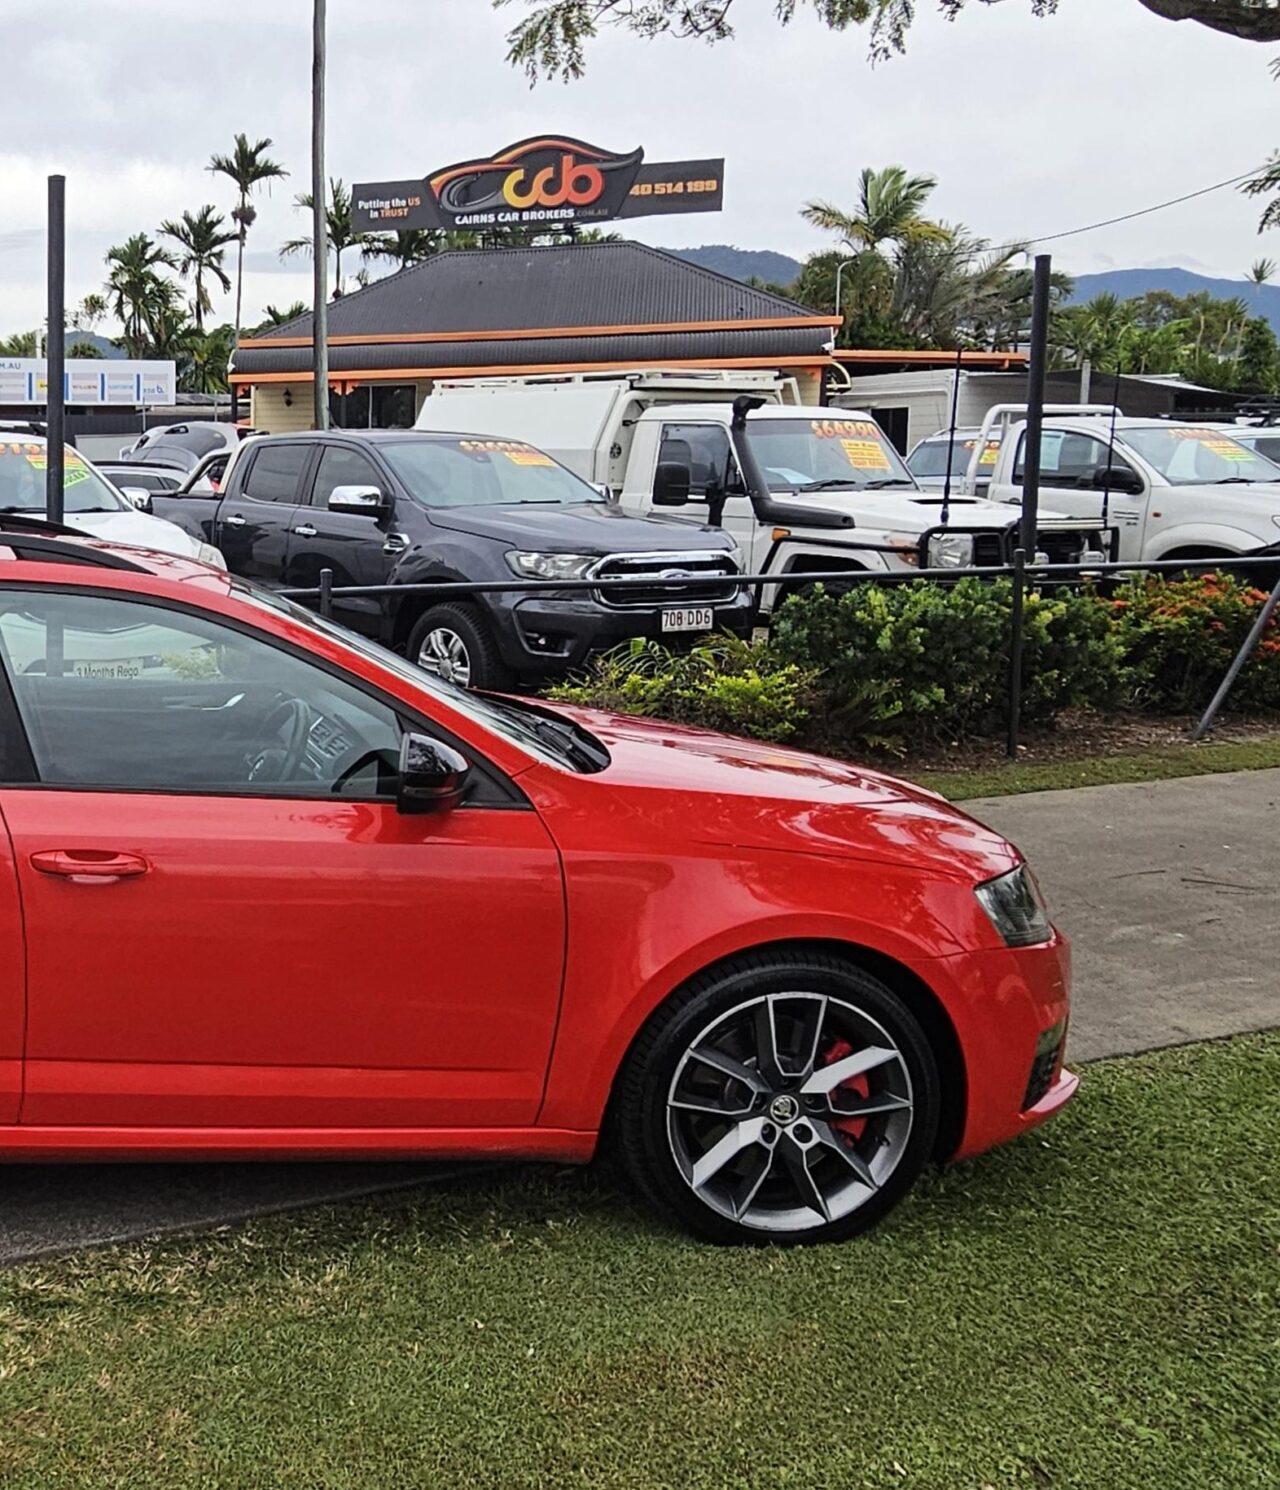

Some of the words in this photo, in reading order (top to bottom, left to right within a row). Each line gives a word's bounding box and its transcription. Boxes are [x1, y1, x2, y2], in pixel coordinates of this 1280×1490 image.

[629, 183, 651, 196] 40
[654, 181, 685, 195] 514
[687, 179, 717, 193] 199
[358, 199, 391, 210] Putting
[391, 197, 406, 208] the
[407, 196, 420, 206] US
[380, 207, 408, 218] TRUST
[455, 214, 495, 225] CAIRNS
[497, 212, 519, 223] CAR
[663, 611, 683, 628] 708
[687, 609, 711, 625] DD6
[84, 665, 115, 679] Months
[117, 665, 139, 680] Rego
